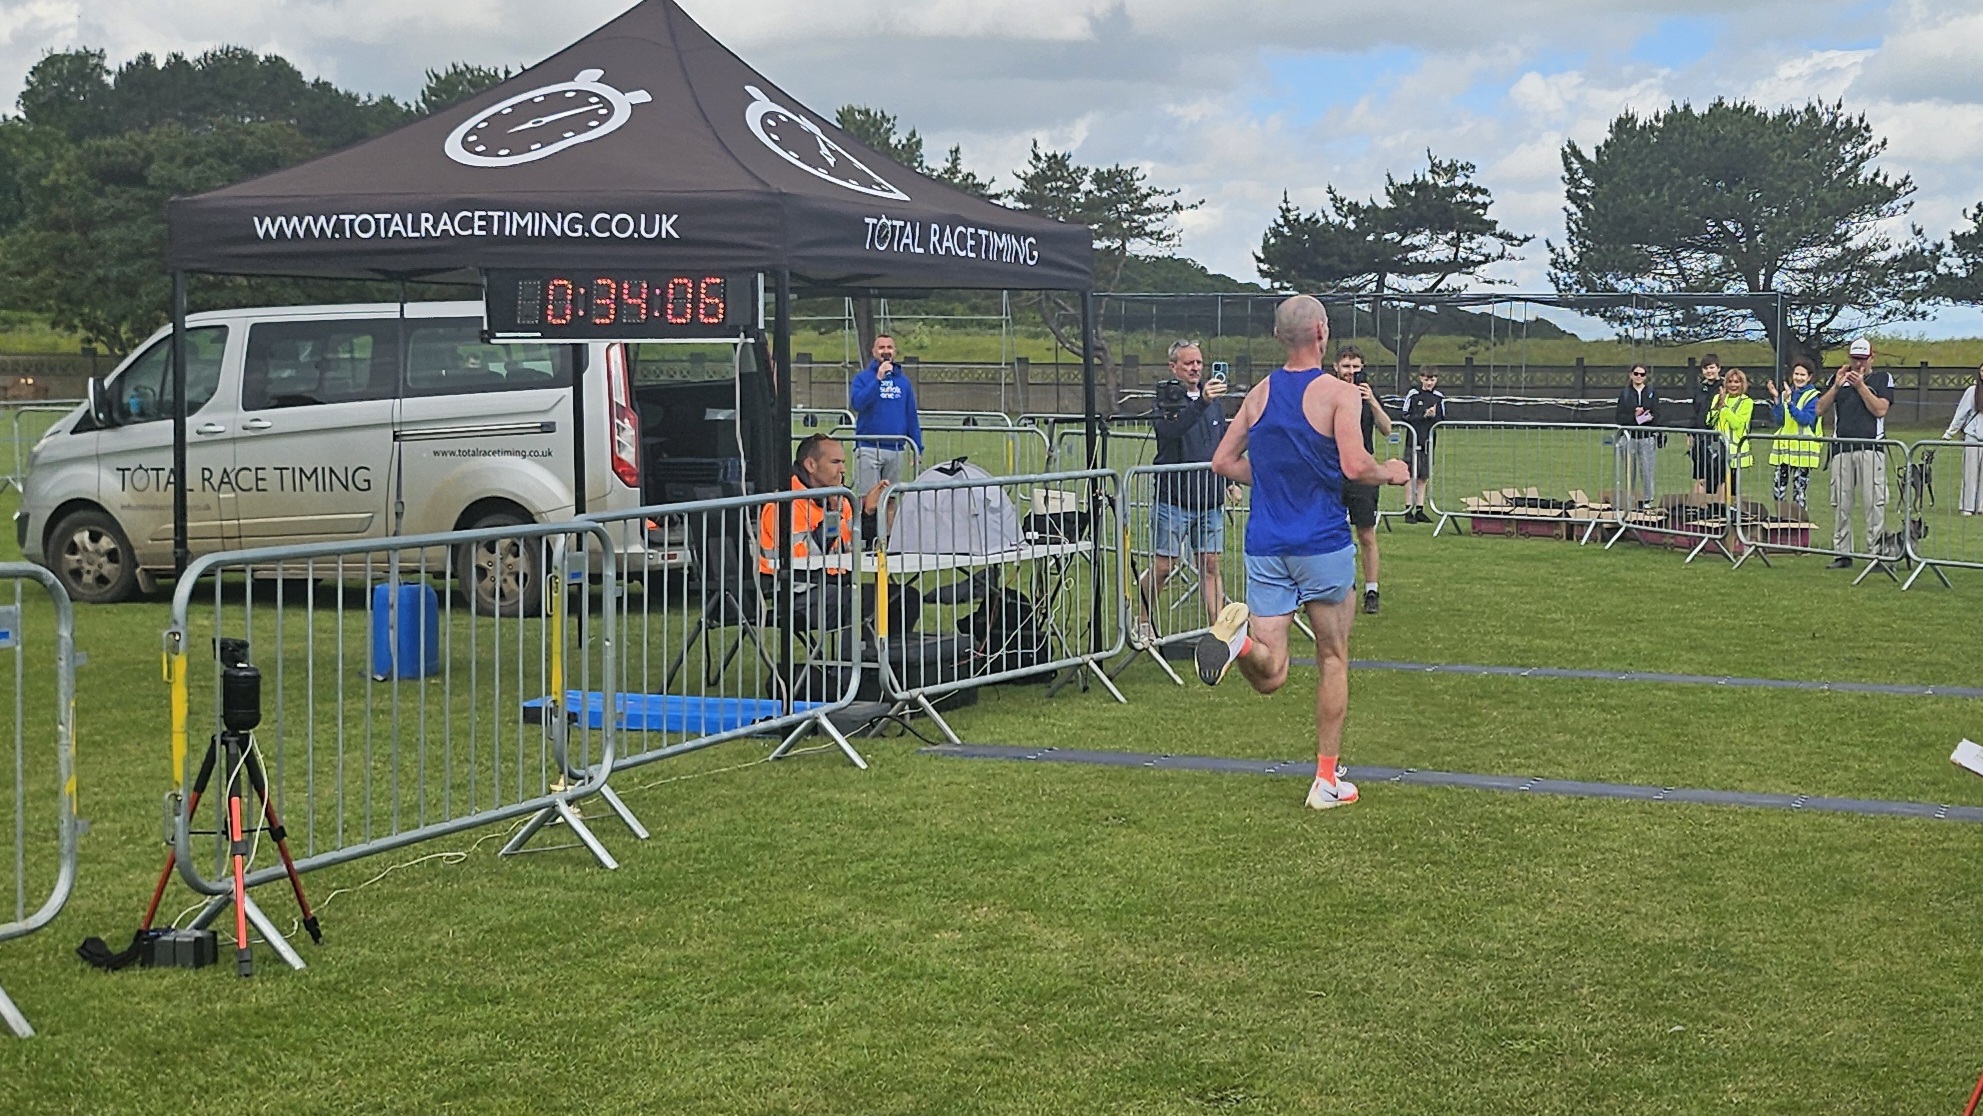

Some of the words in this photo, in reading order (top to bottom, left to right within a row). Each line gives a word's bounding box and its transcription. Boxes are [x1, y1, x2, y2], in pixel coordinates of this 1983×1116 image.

[253, 210, 680, 240] WWW.TOTALRACETIMING.CO.UK
[864, 214, 925, 254] TOTAL
[929, 223, 977, 259] RACE
[977, 229, 1039, 266] TIMING
[547, 277, 725, 325] 0:34:06
[433, 447, 553, 459] www.totalracetiming.co.uk
[201, 465, 268, 493] RACE
[273, 464, 373, 493] TIMING
